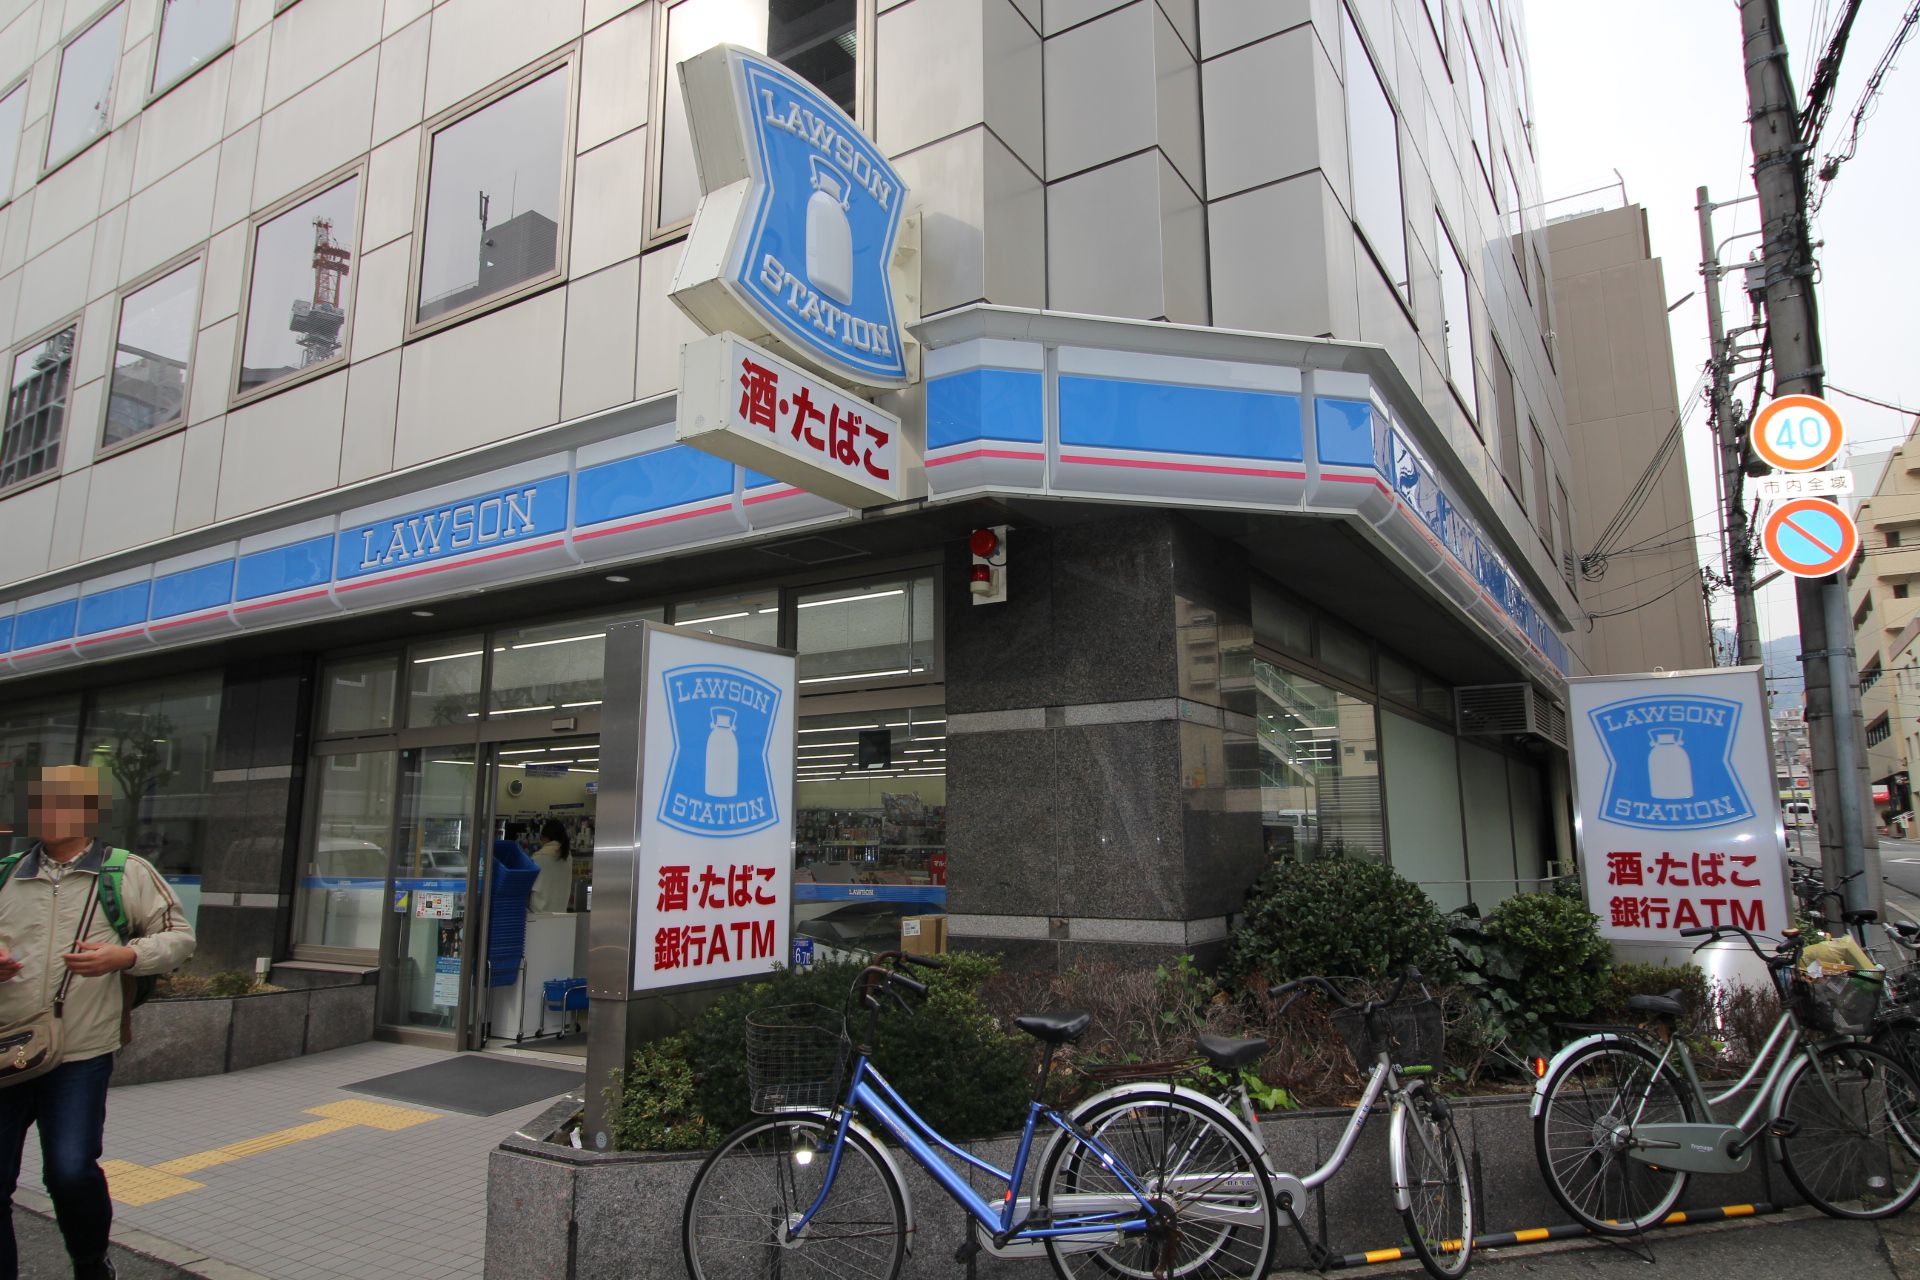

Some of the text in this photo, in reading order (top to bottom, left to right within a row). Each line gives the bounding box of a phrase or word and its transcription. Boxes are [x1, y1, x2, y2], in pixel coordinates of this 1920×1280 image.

[761, 88, 892, 211] LAWSON
[760, 253, 892, 357] STATION
[738, 357, 890, 481] 酒・たばこ
[1775, 416, 1823, 449] 40
[1763, 475, 1848, 495] 市内全域
[359, 487, 537, 570] LAWSON
[676, 677, 770, 714] LAWSON
[1603, 705, 1726, 732] LAWSON
[673, 793, 766, 825] STATION
[1615, 796, 1735, 821] STATION
[1606, 851, 1762, 888] 酒・たばこ
[656, 864, 776, 913] 酒・たばこ
[1610, 896, 1766, 932] 銀行ATM
[654, 919, 775, 971] 銀行ATM
